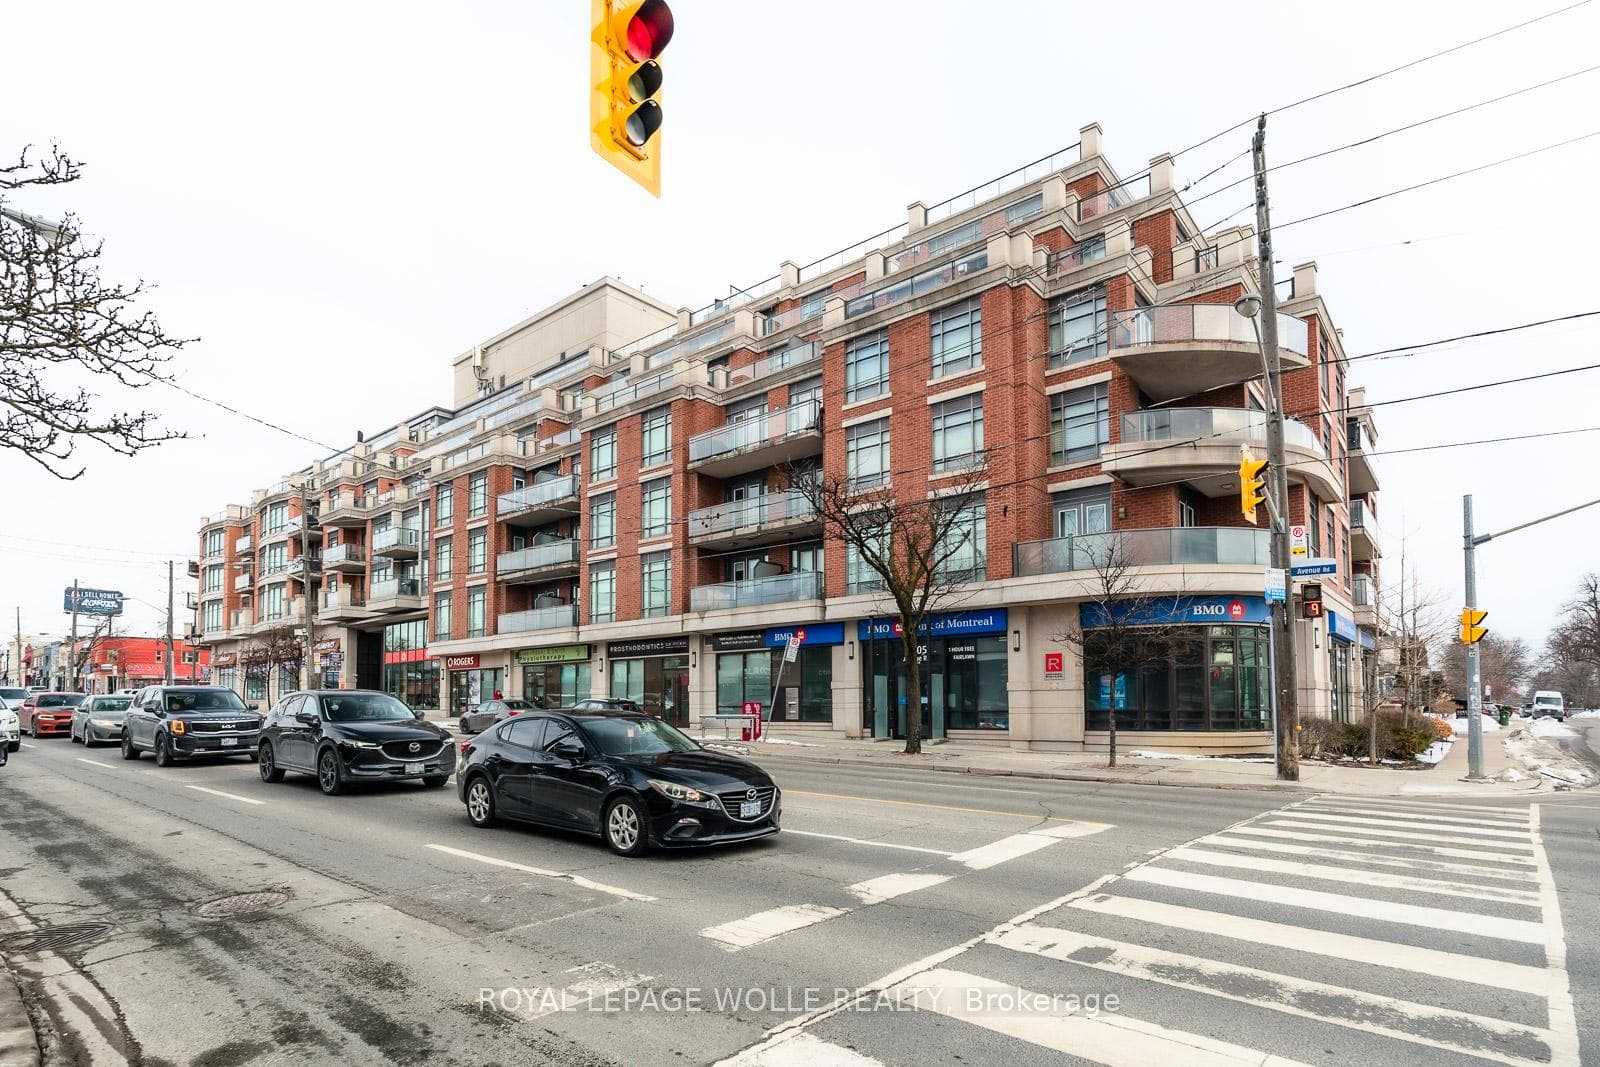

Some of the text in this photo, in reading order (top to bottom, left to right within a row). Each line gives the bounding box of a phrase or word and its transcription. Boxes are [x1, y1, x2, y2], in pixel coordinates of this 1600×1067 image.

[1296, 567, 1321, 575] Avenue
[1193, 604, 1225, 615] BMO
[1312, 603, 1319, 614] 9
[935, 620, 944, 629] of
[946, 616, 993, 629] Montreal
[774, 632, 793, 642] BMO
[610, 642, 665, 652] PROSTHODONTICS
[453, 656, 474, 666] ROGERS
[519, 654, 566, 662] Physiotherapy
